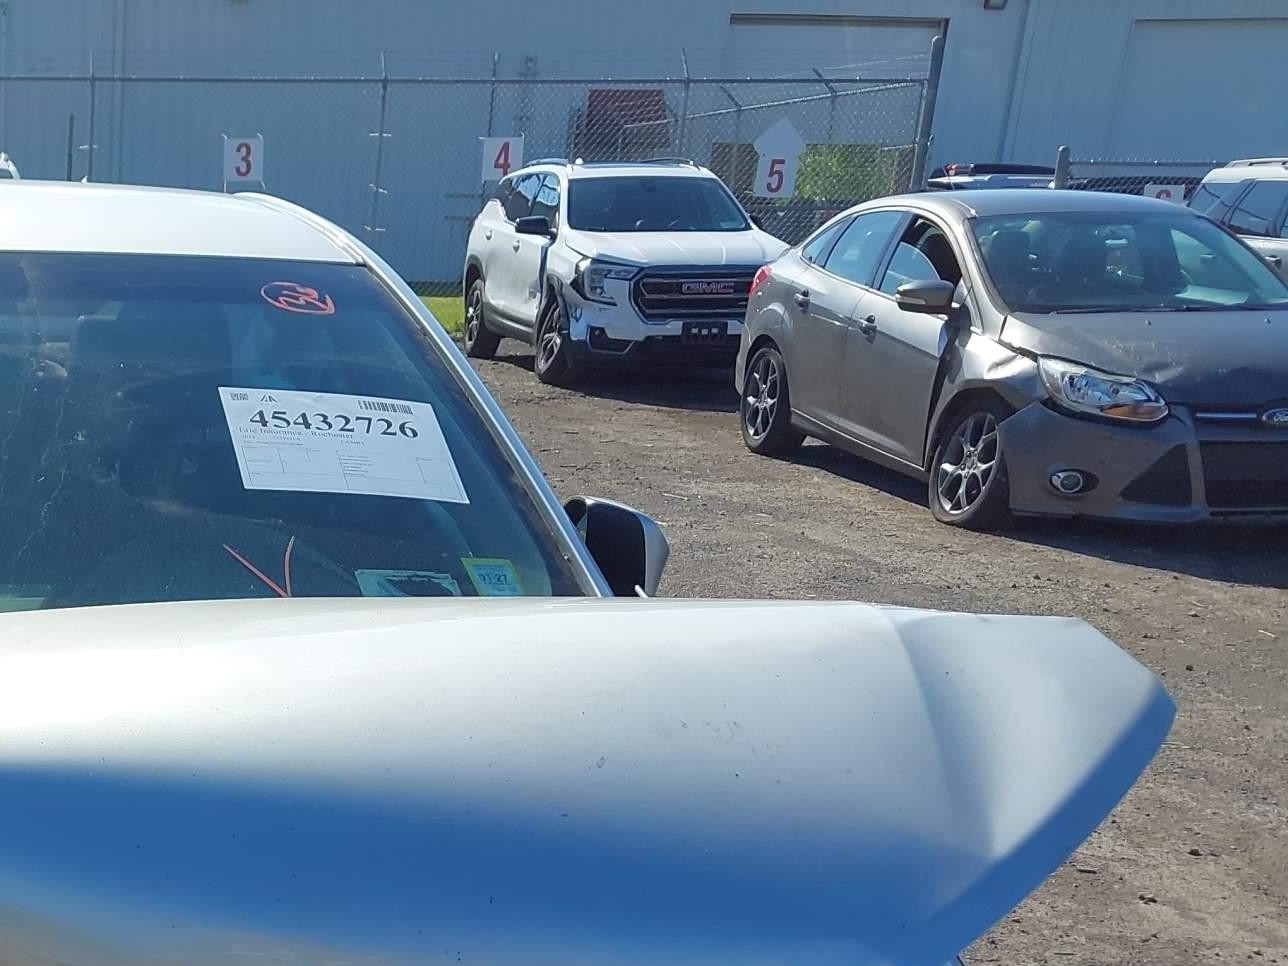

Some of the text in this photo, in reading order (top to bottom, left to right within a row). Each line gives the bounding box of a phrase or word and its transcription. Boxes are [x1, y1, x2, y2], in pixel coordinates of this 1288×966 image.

[235, 142, 252, 177] 3
[494, 141, 511, 176] 4
[766, 158, 786, 193] 5
[681, 281, 734, 294] GMC
[249, 408, 419, 439] 45432726
